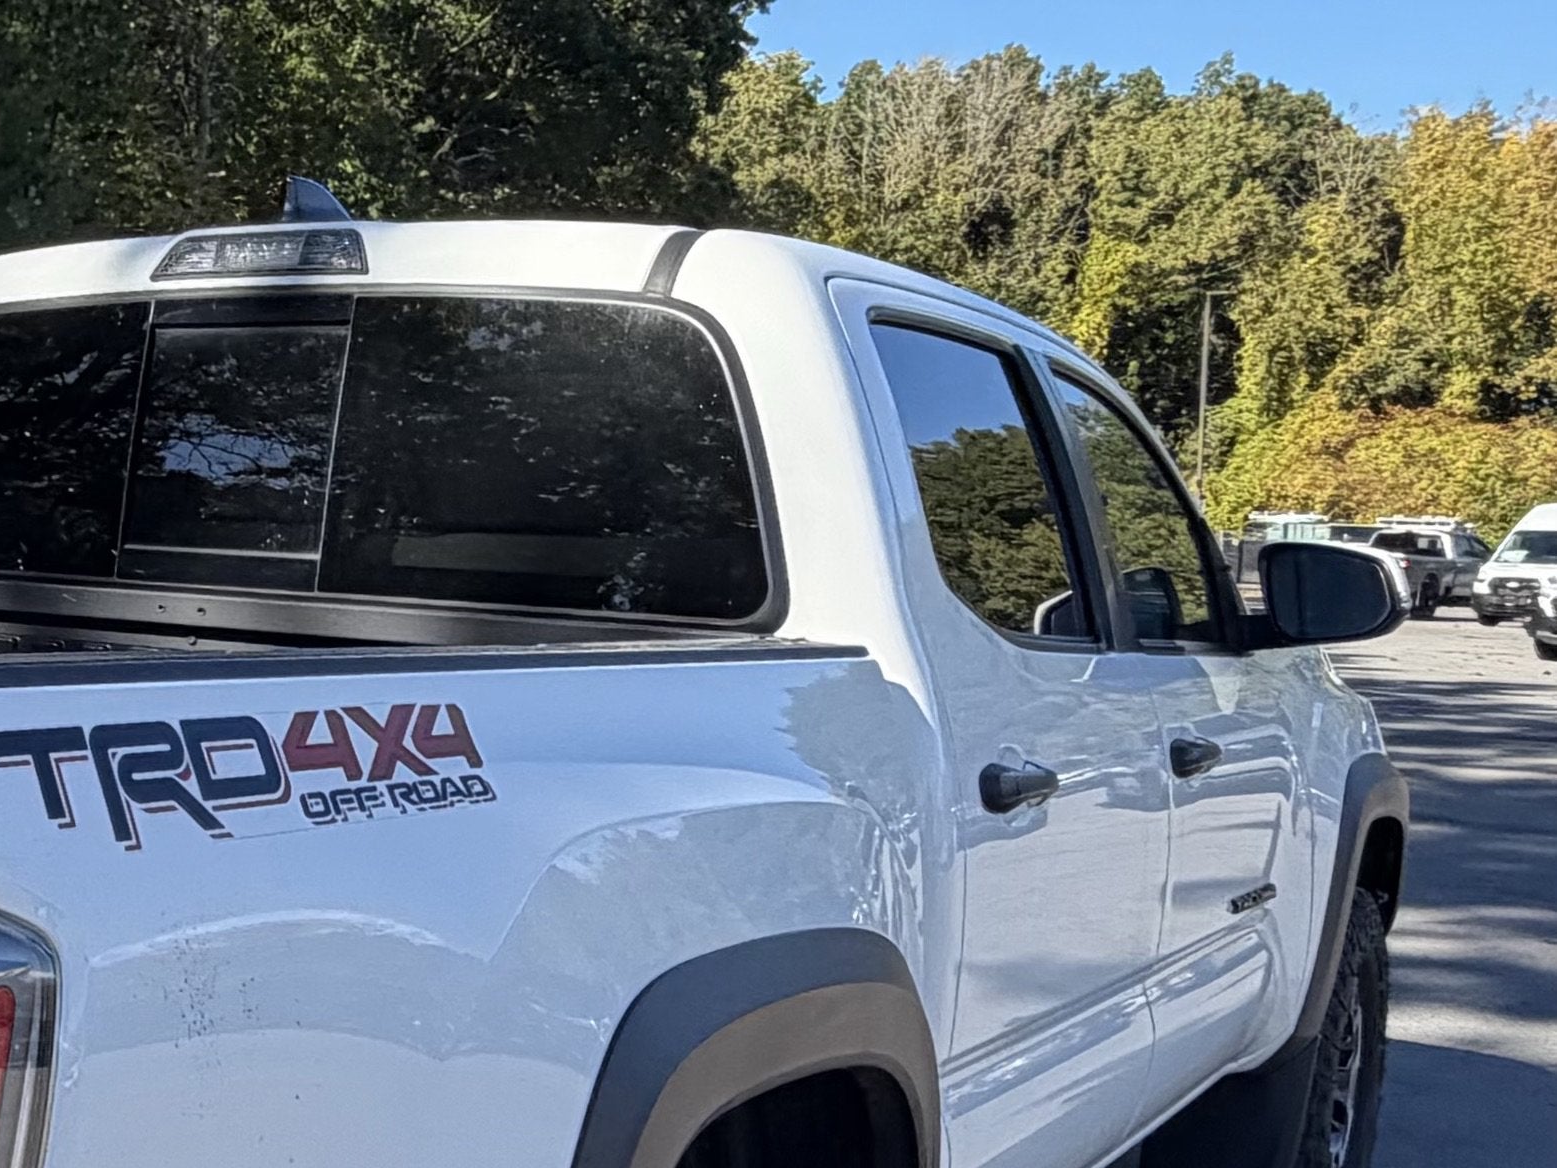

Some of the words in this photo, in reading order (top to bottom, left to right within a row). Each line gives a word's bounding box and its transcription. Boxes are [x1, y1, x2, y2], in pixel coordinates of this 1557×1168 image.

[281, 703, 484, 783] 4X4
[300, 783, 386, 826] OFF
[386, 774, 498, 814] ROAD
